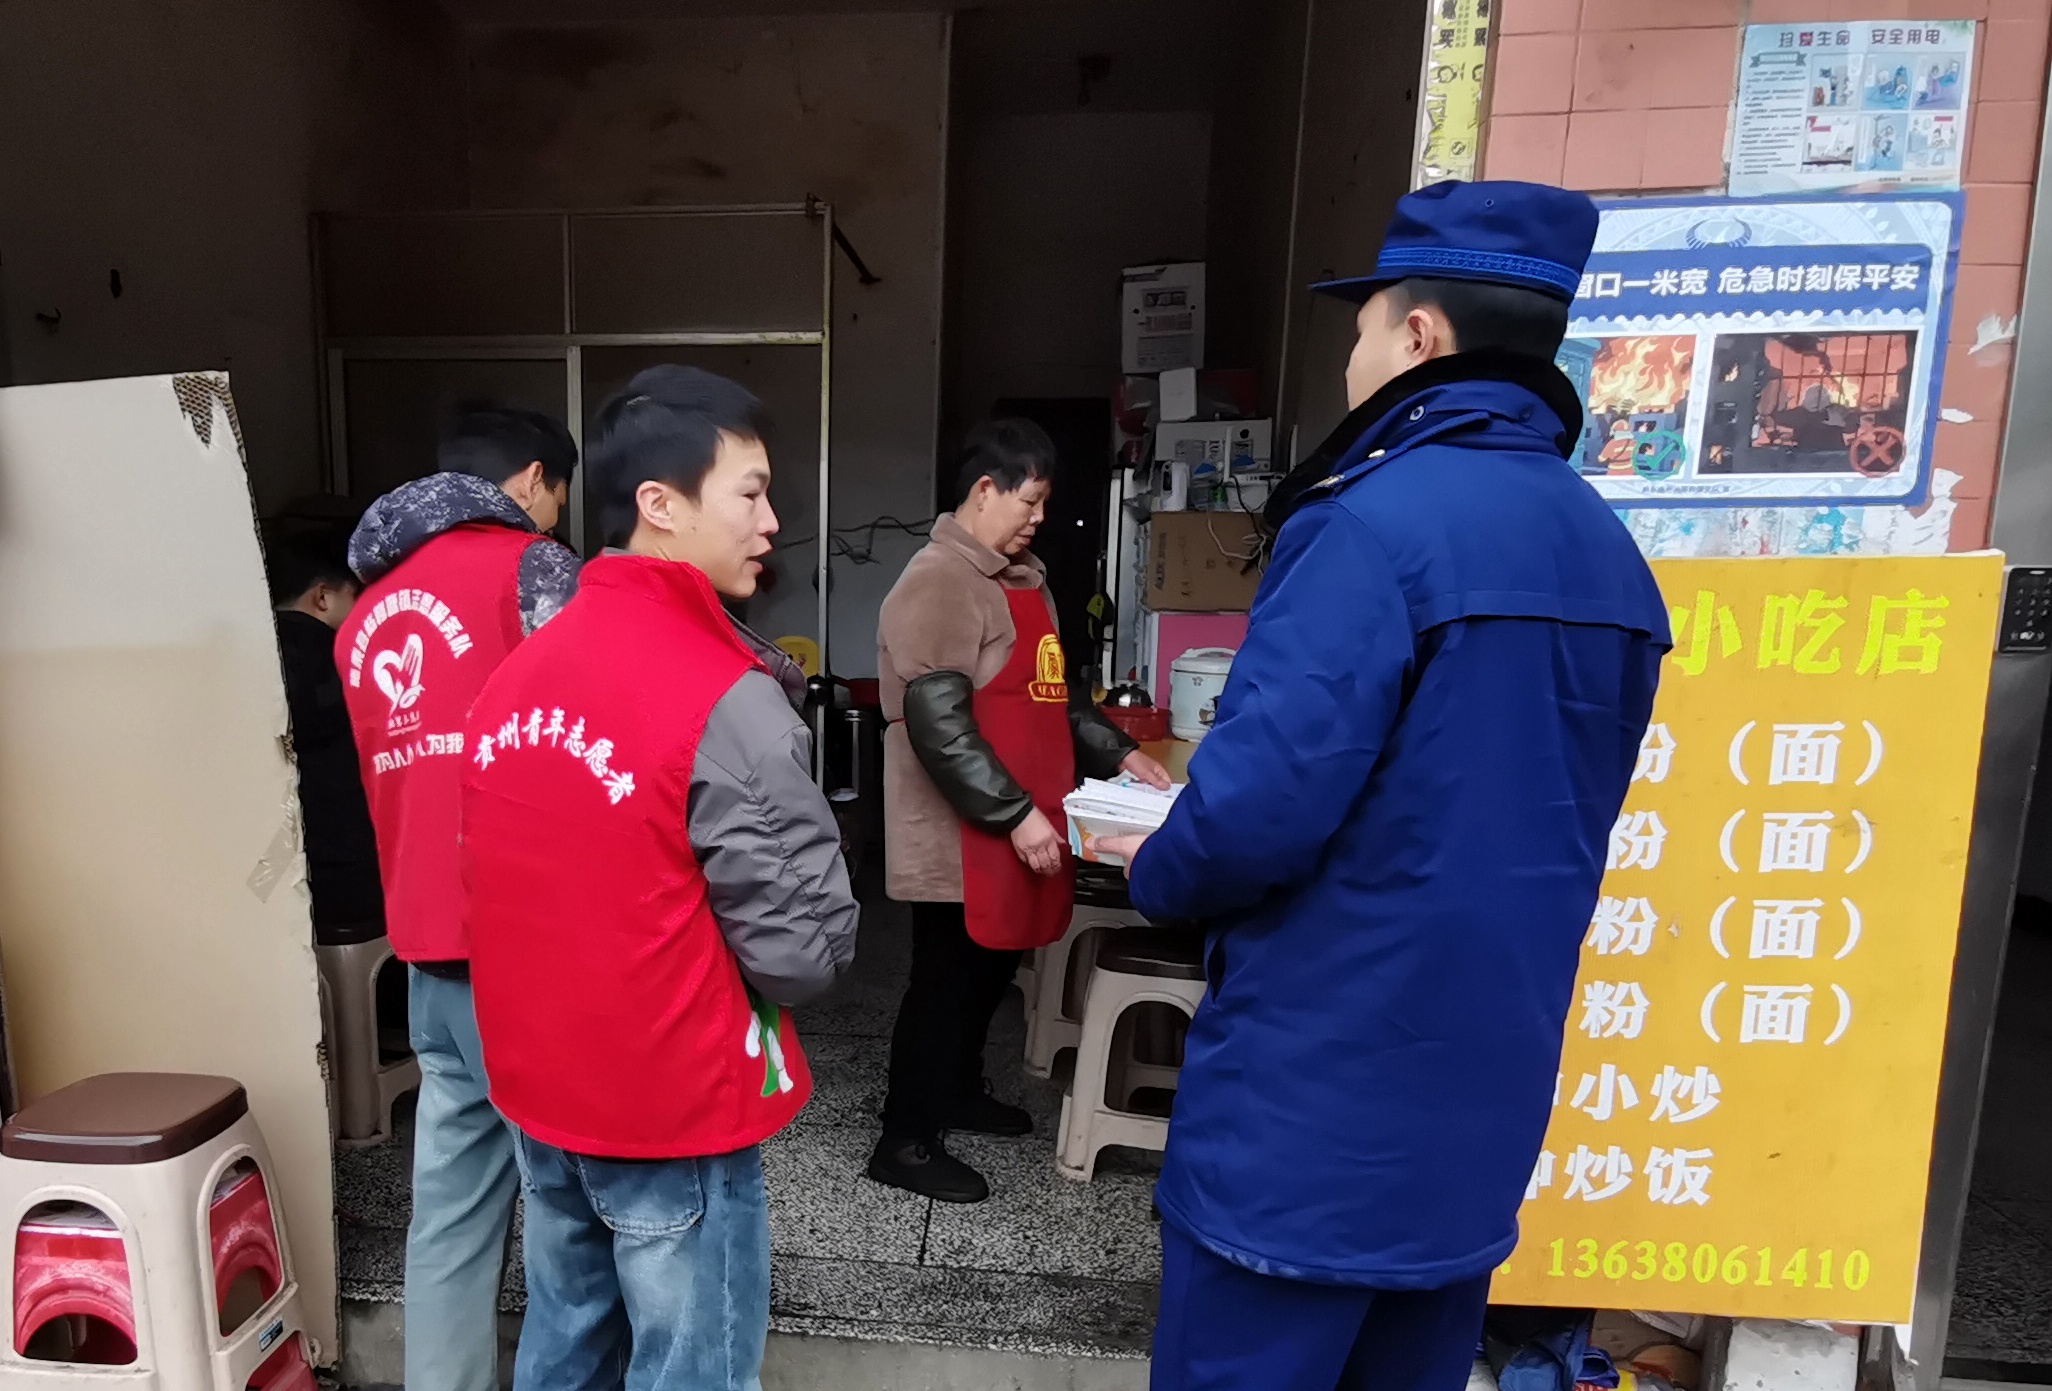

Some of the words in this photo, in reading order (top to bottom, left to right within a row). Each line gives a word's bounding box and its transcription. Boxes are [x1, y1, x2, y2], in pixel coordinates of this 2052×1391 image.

[1779, 31, 1851, 48] 珍爱生命
[1871, 28, 1940, 46] 安全用电
[1717, 263, 1919, 294] 危急时刻保平安
[1670, 587, 1950, 677] 小吃店
[474, 705, 636, 806] 贵州青年志愿者
[1578, 980, 1852, 1046] 粉（面）
[1552, 1062, 1722, 1123] 小炒
[1546, 1237, 1871, 1292] 13638061410
